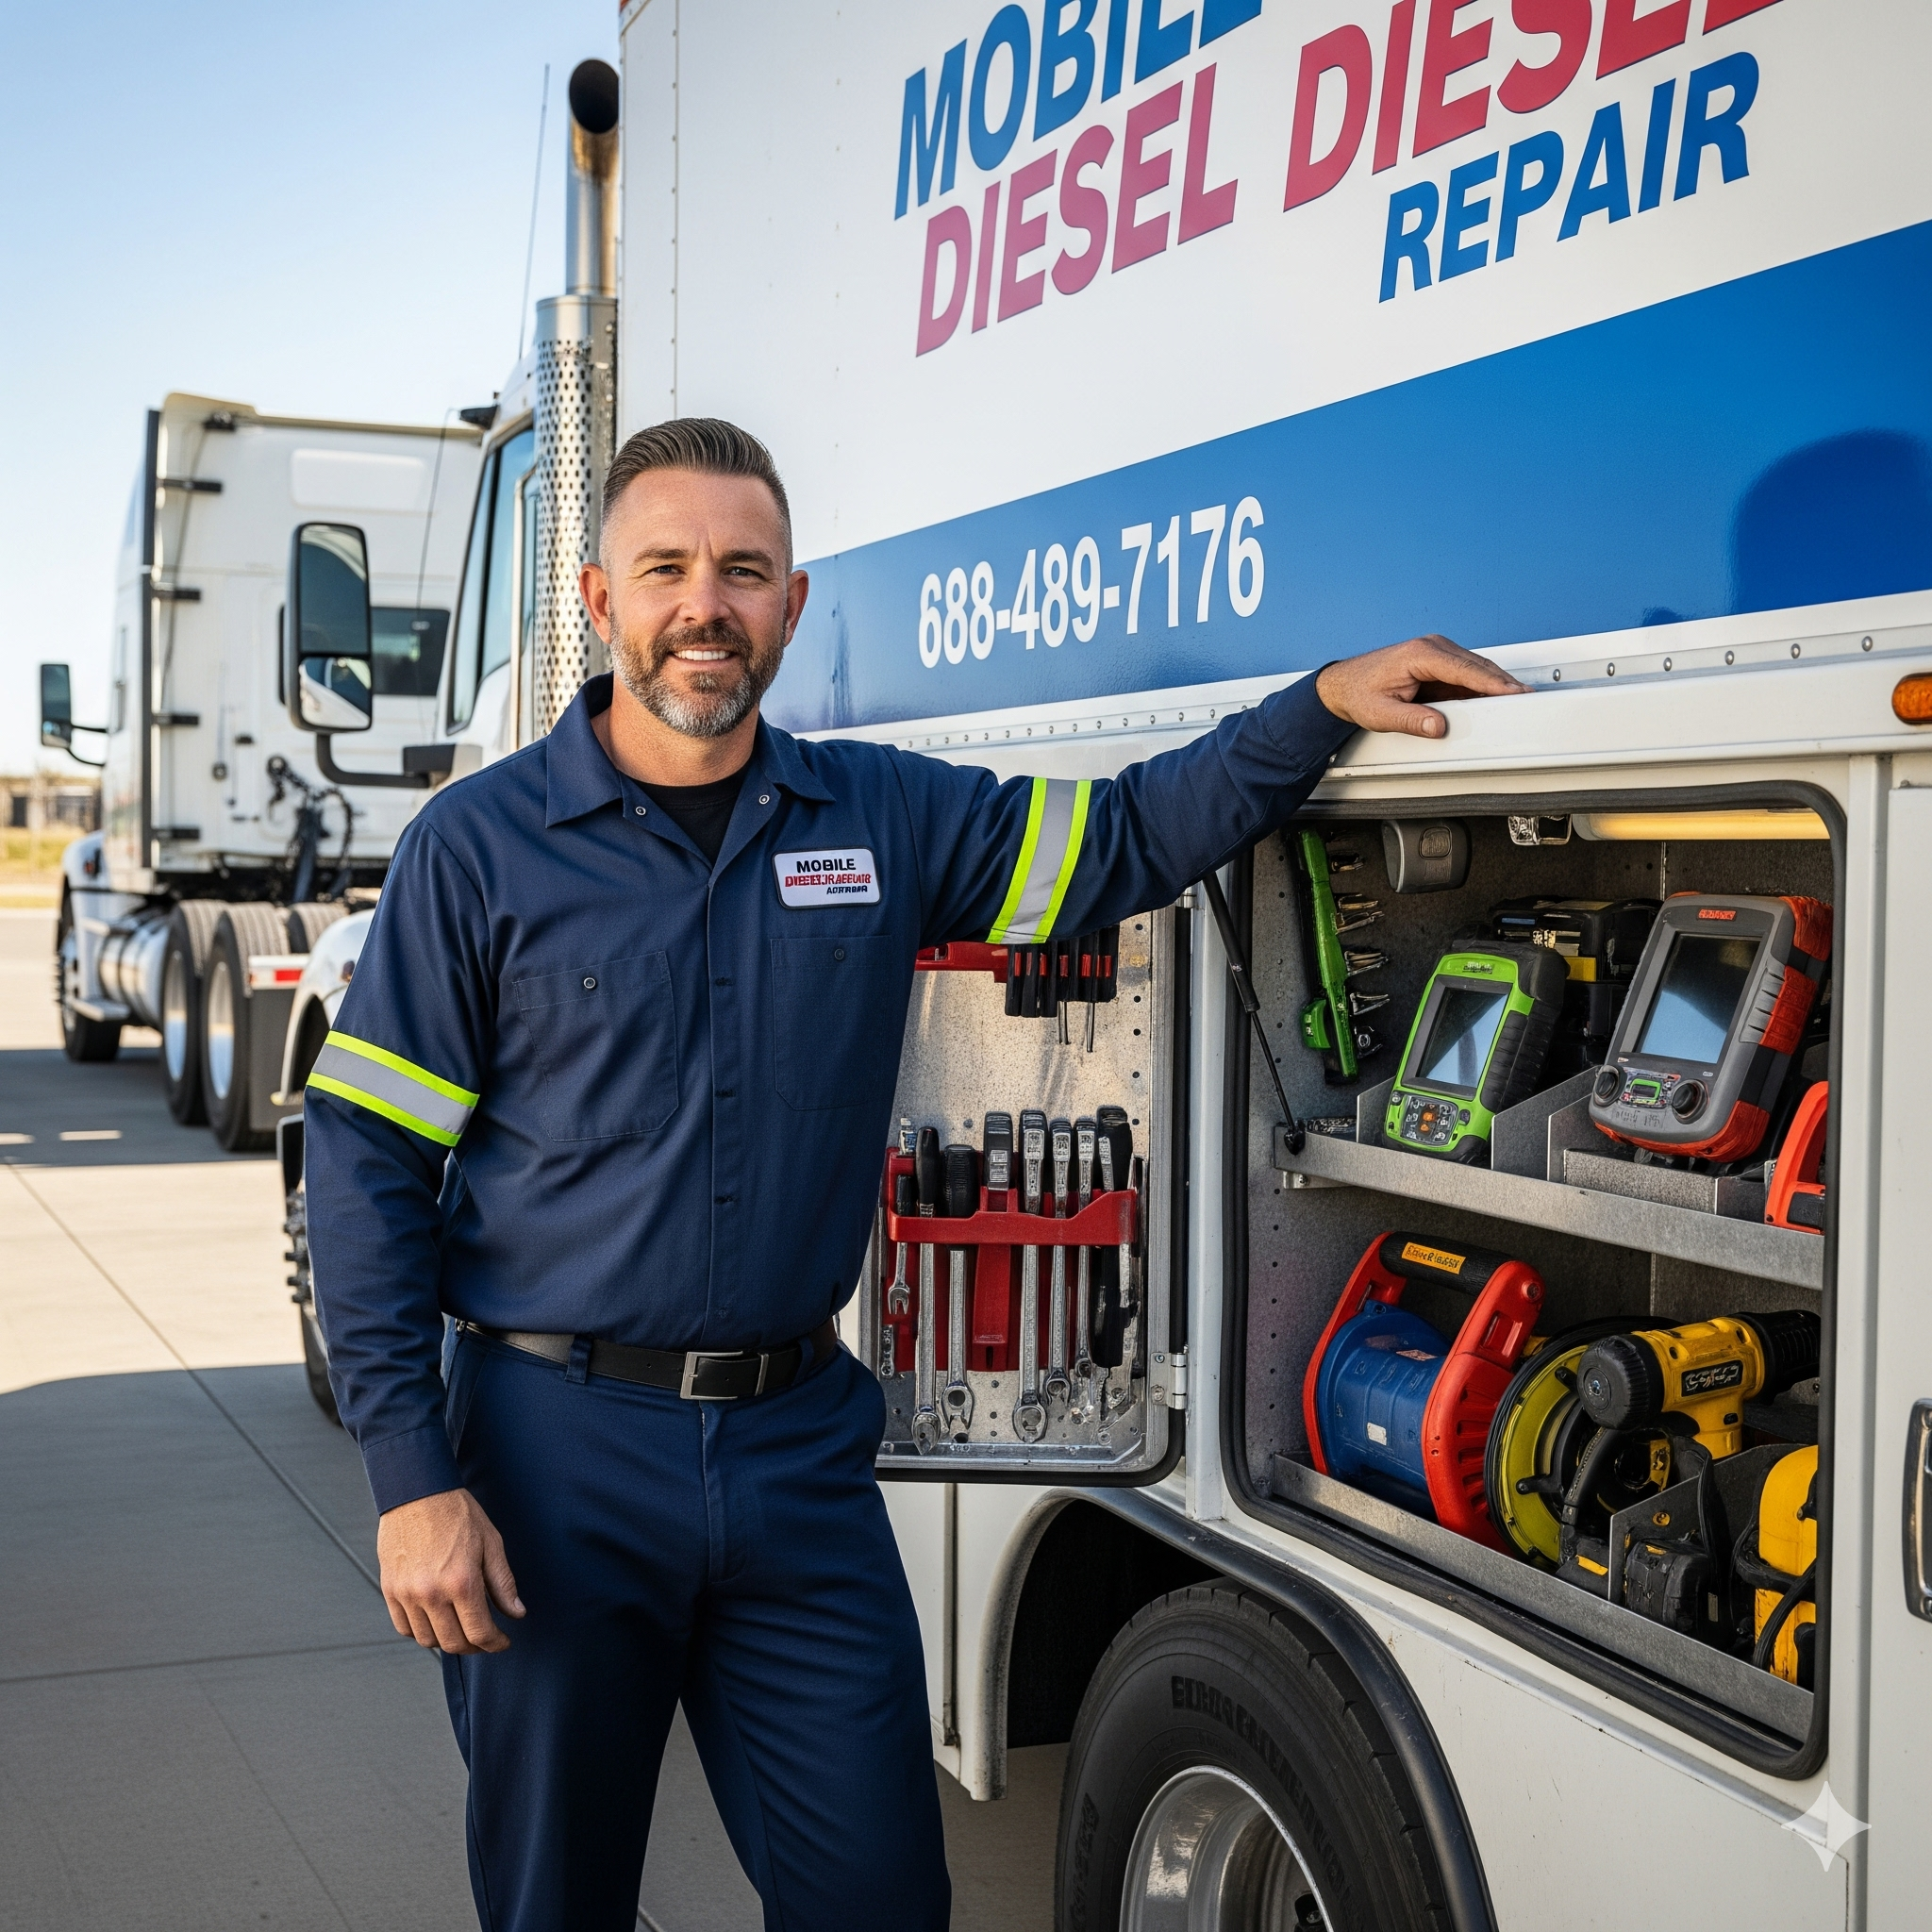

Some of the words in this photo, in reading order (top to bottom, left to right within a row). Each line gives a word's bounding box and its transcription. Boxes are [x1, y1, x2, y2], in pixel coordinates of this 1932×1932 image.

[895, 0, 1262, 219] MOBIL
[916, 63, 1238, 357] DIESEL
[1284, 0, 1779, 211] DIES
[1379, 51, 1759, 303] REPAIR
[919, 496, 1265, 669] 688-489-7176
[796, 858, 856, 874] MOBILE
